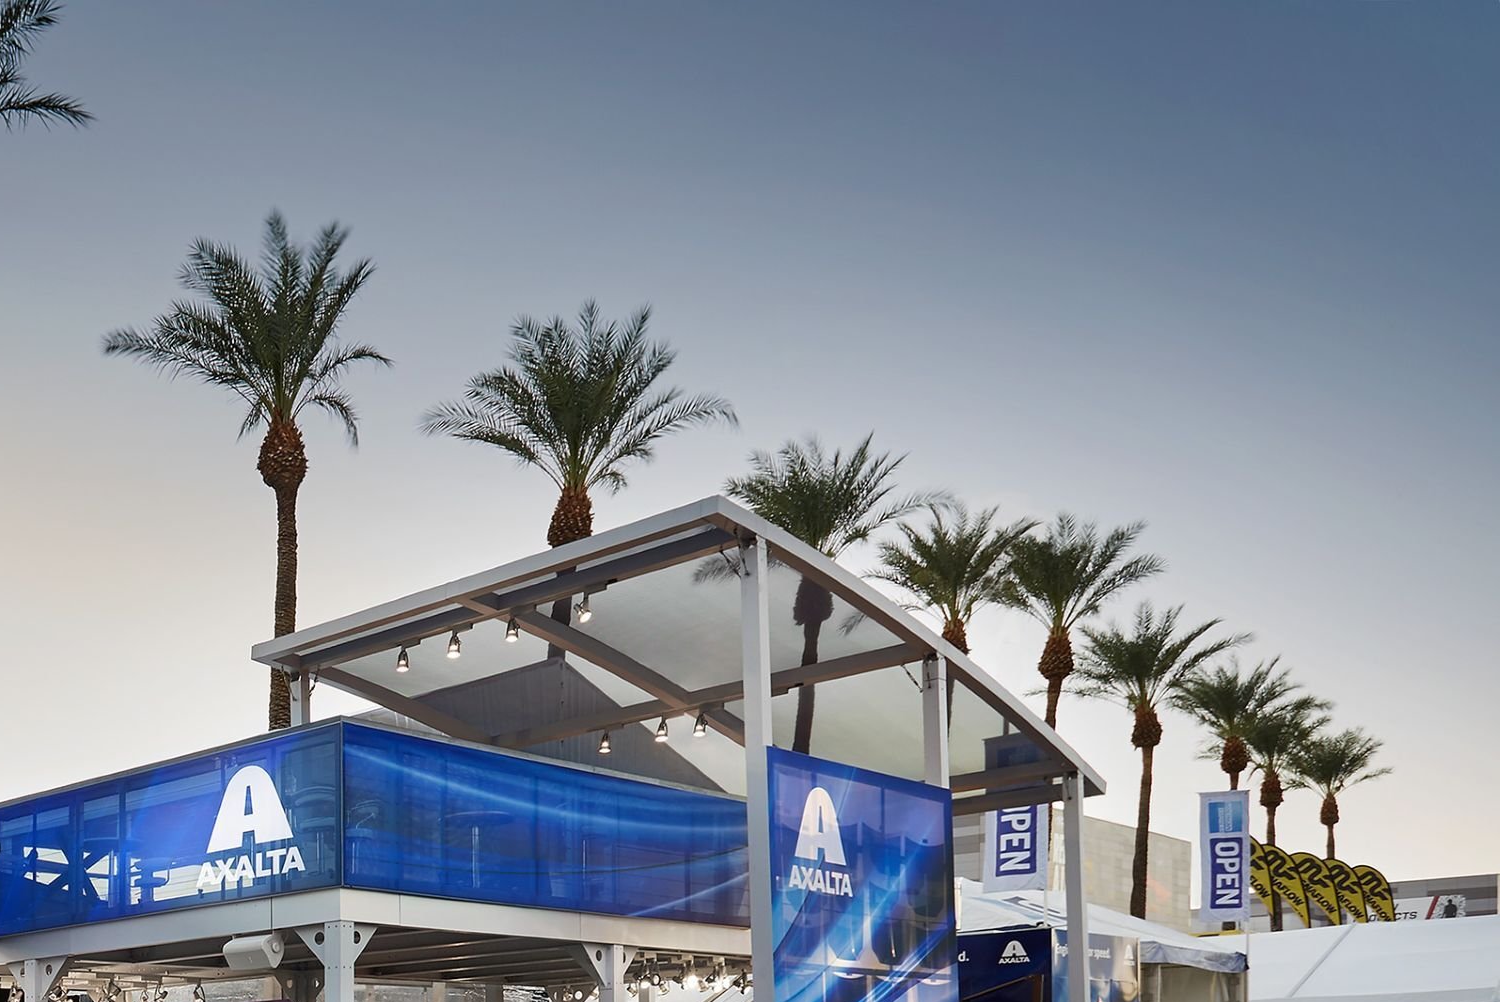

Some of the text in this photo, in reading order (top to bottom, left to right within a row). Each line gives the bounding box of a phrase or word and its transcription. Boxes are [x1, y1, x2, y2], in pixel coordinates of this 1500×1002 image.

[196, 846, 306, 891] AXALTA
[788, 865, 853, 897] AXALTA
[1215, 841, 1240, 905] OPEN
[998, 956, 1031, 965] AXALTA
